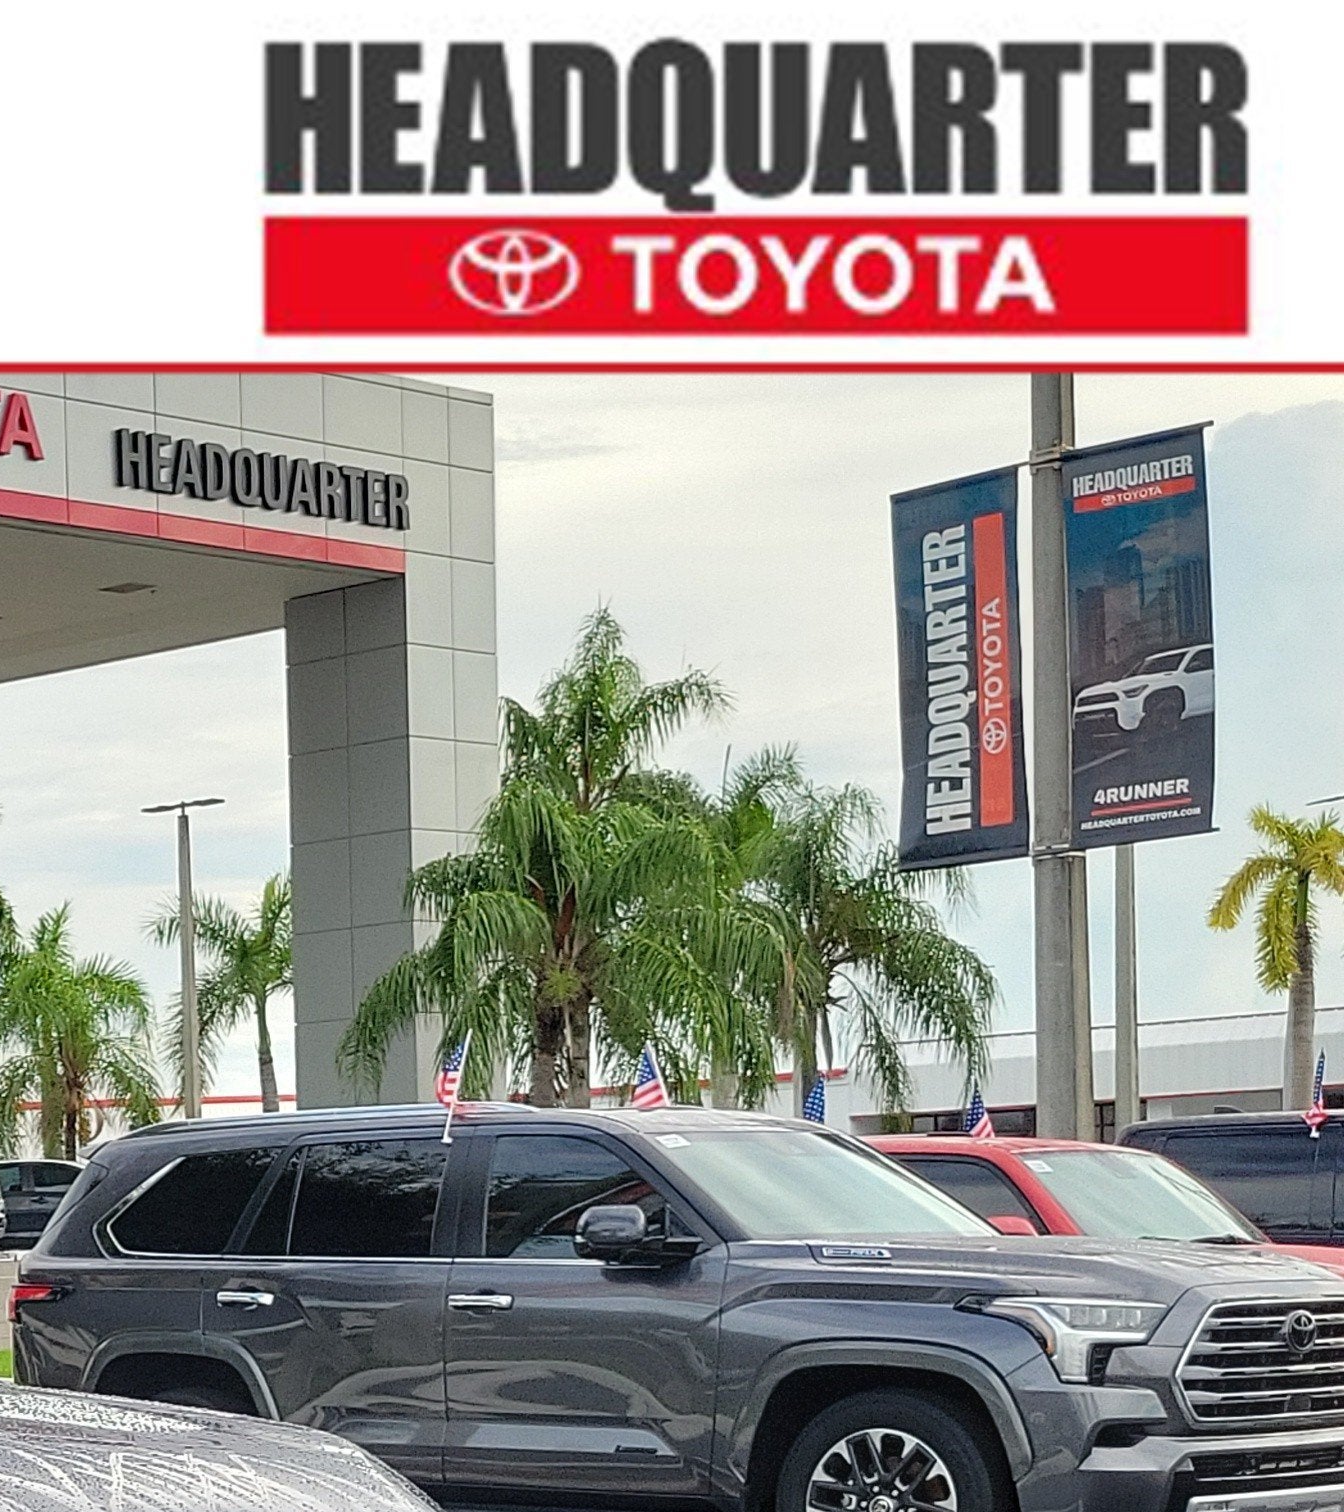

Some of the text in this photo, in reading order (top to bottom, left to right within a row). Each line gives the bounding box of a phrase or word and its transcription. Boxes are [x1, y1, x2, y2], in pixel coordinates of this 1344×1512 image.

[114, 428, 410, 530] HEADQUARTER
[1073, 454, 1193, 498] HEADQUARTER
[1117, 485, 1162, 503] TOYOTA
[922, 523, 978, 836] HEADQUARTER
[982, 597, 1004, 716] TOYOTA
[1093, 778, 1190, 805] 4RUNNER
